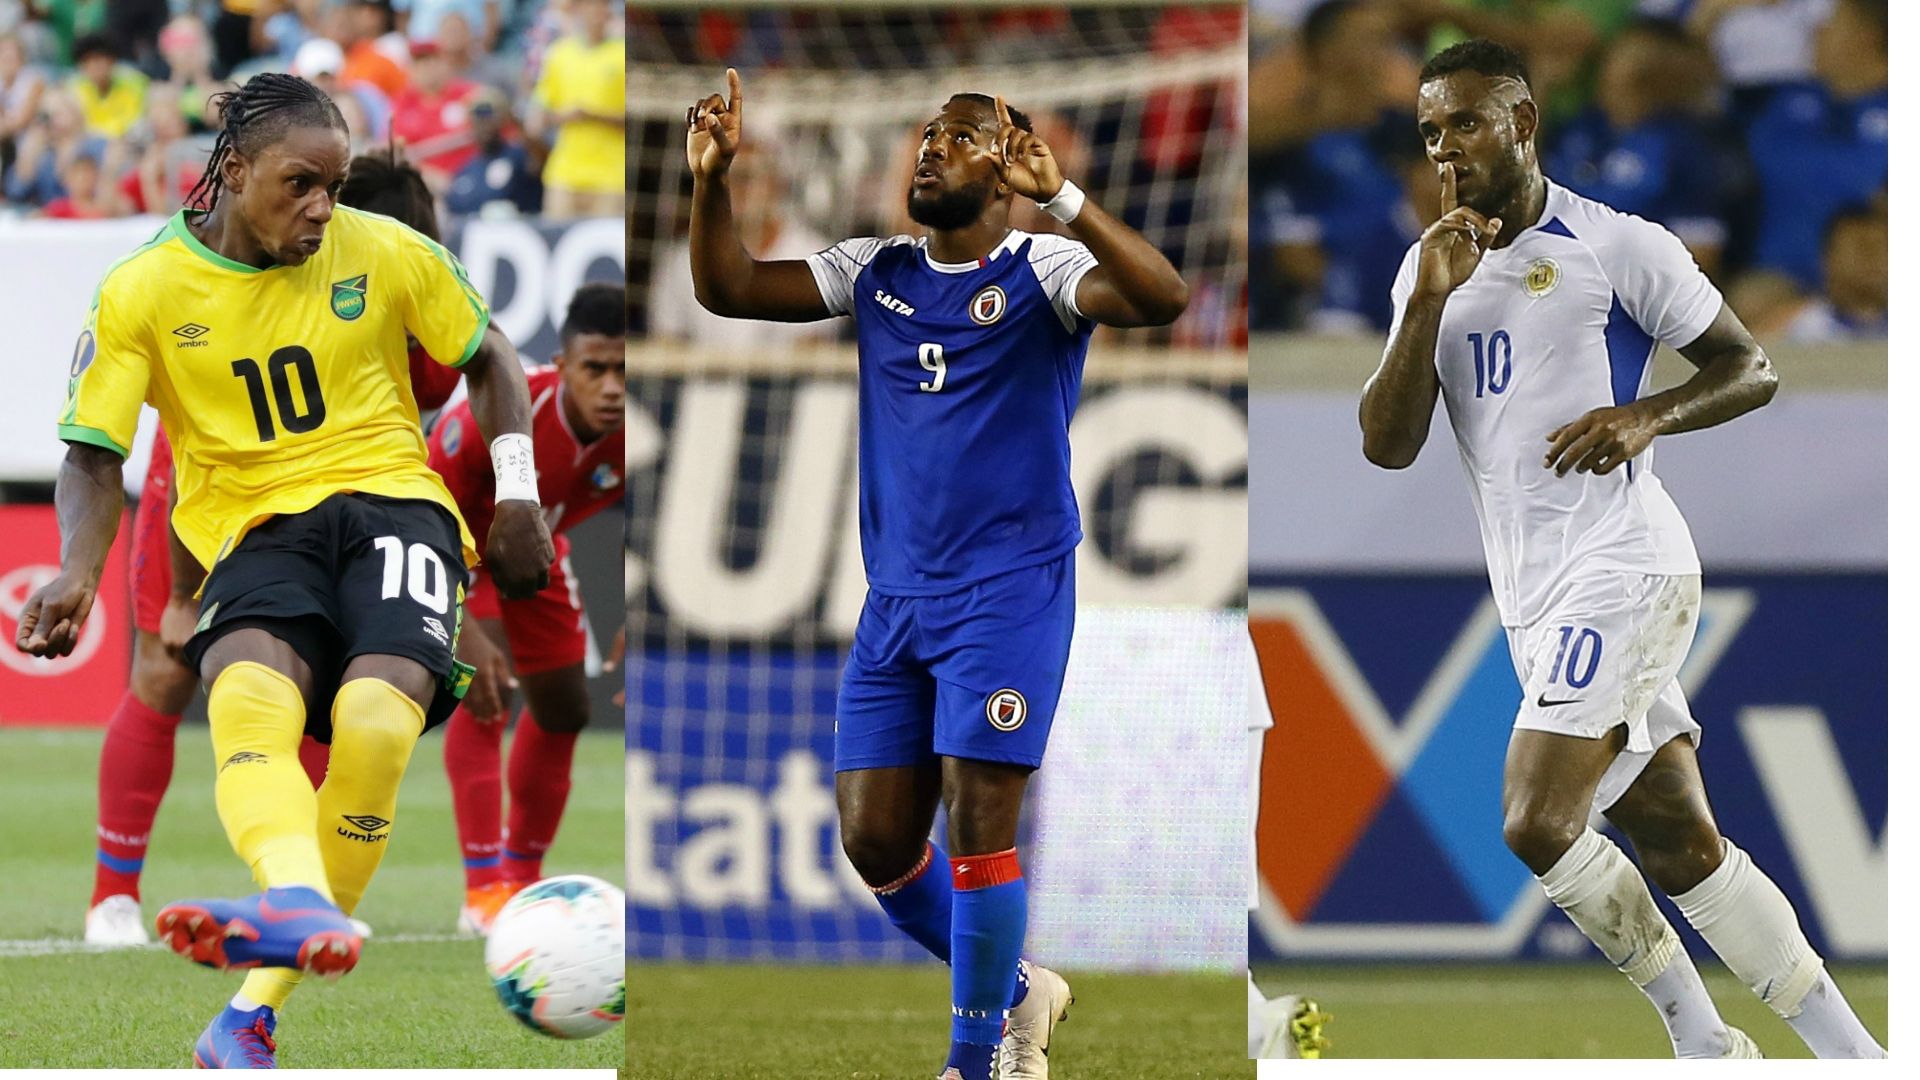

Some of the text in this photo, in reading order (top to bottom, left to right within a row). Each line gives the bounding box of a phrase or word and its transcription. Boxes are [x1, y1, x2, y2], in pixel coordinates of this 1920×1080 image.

[874, 289, 915, 317] SAETA
[177, 340, 209, 348] umbro
[918, 342, 947, 392] 9
[1467, 330, 1511, 398] 10
[231, 344, 326, 442] 10
[374, 535, 449, 615] 10
[1547, 626, 1603, 690] 10
